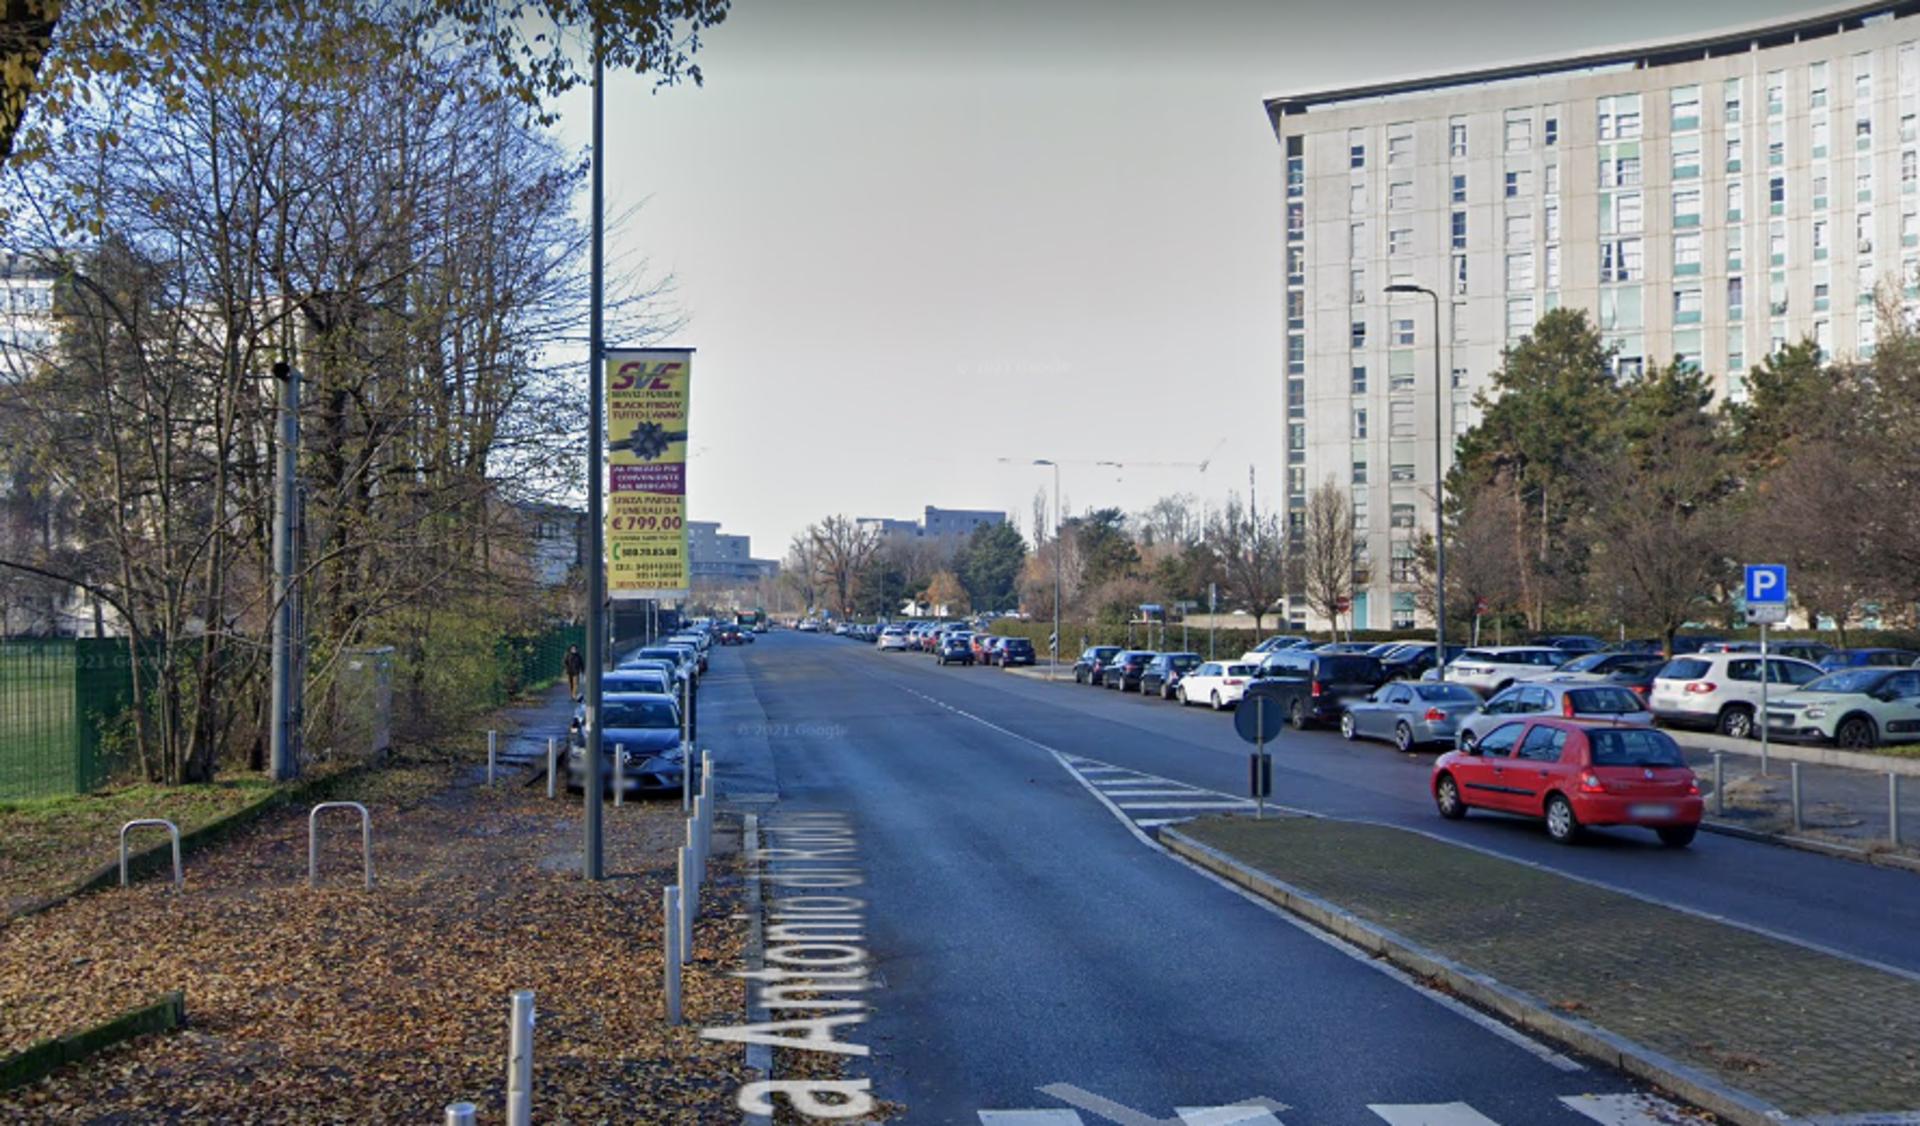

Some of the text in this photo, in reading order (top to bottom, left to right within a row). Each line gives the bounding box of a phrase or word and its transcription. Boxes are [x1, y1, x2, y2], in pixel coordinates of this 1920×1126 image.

[611, 516, 682, 531] € 799,00
[1753, 570, 1777, 599] P
